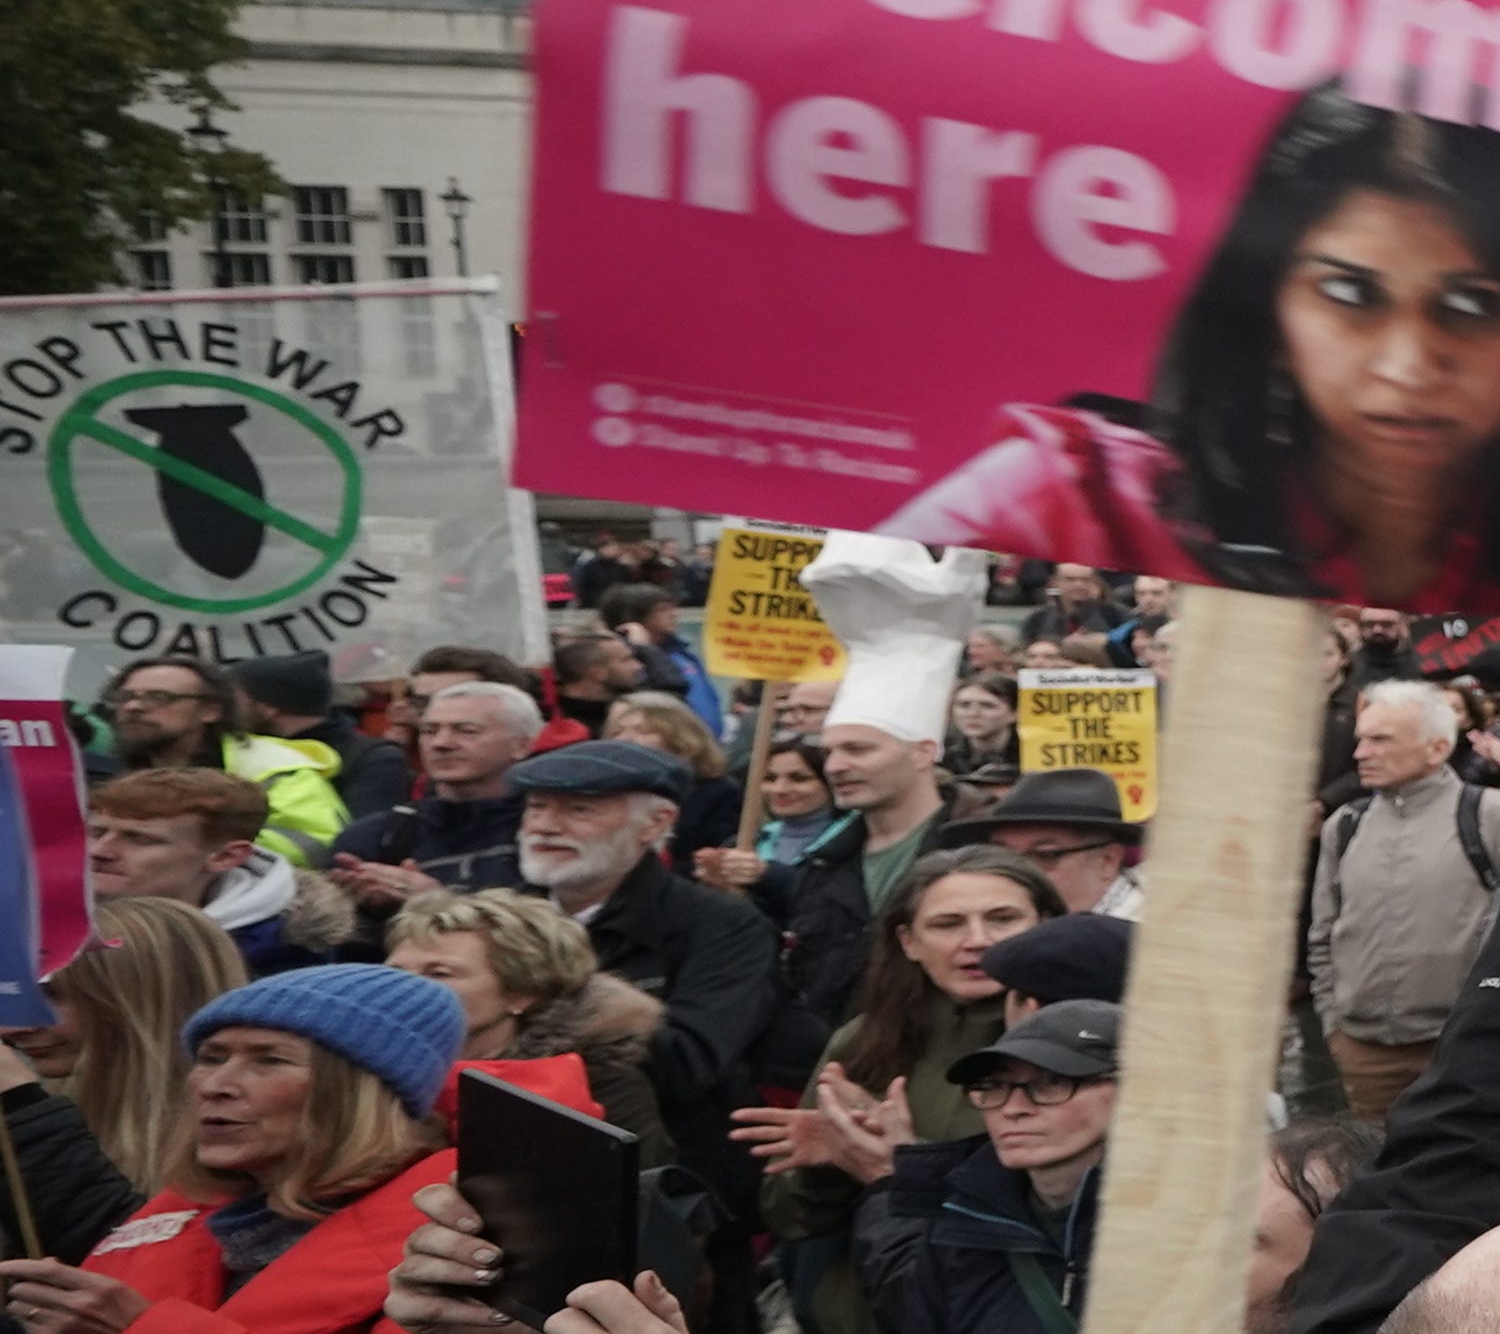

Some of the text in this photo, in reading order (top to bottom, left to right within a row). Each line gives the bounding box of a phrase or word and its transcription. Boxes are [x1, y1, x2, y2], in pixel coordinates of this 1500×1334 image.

[600, 7, 1178, 281] here
[0, 319, 405, 456] STOP THE WAR
[57, 560, 398, 665] COALITION
[1031, 691, 1142, 716] SUPPORT
[1070, 718, 1112, 739] THE
[1040, 741, 1140, 766] STRIKES
